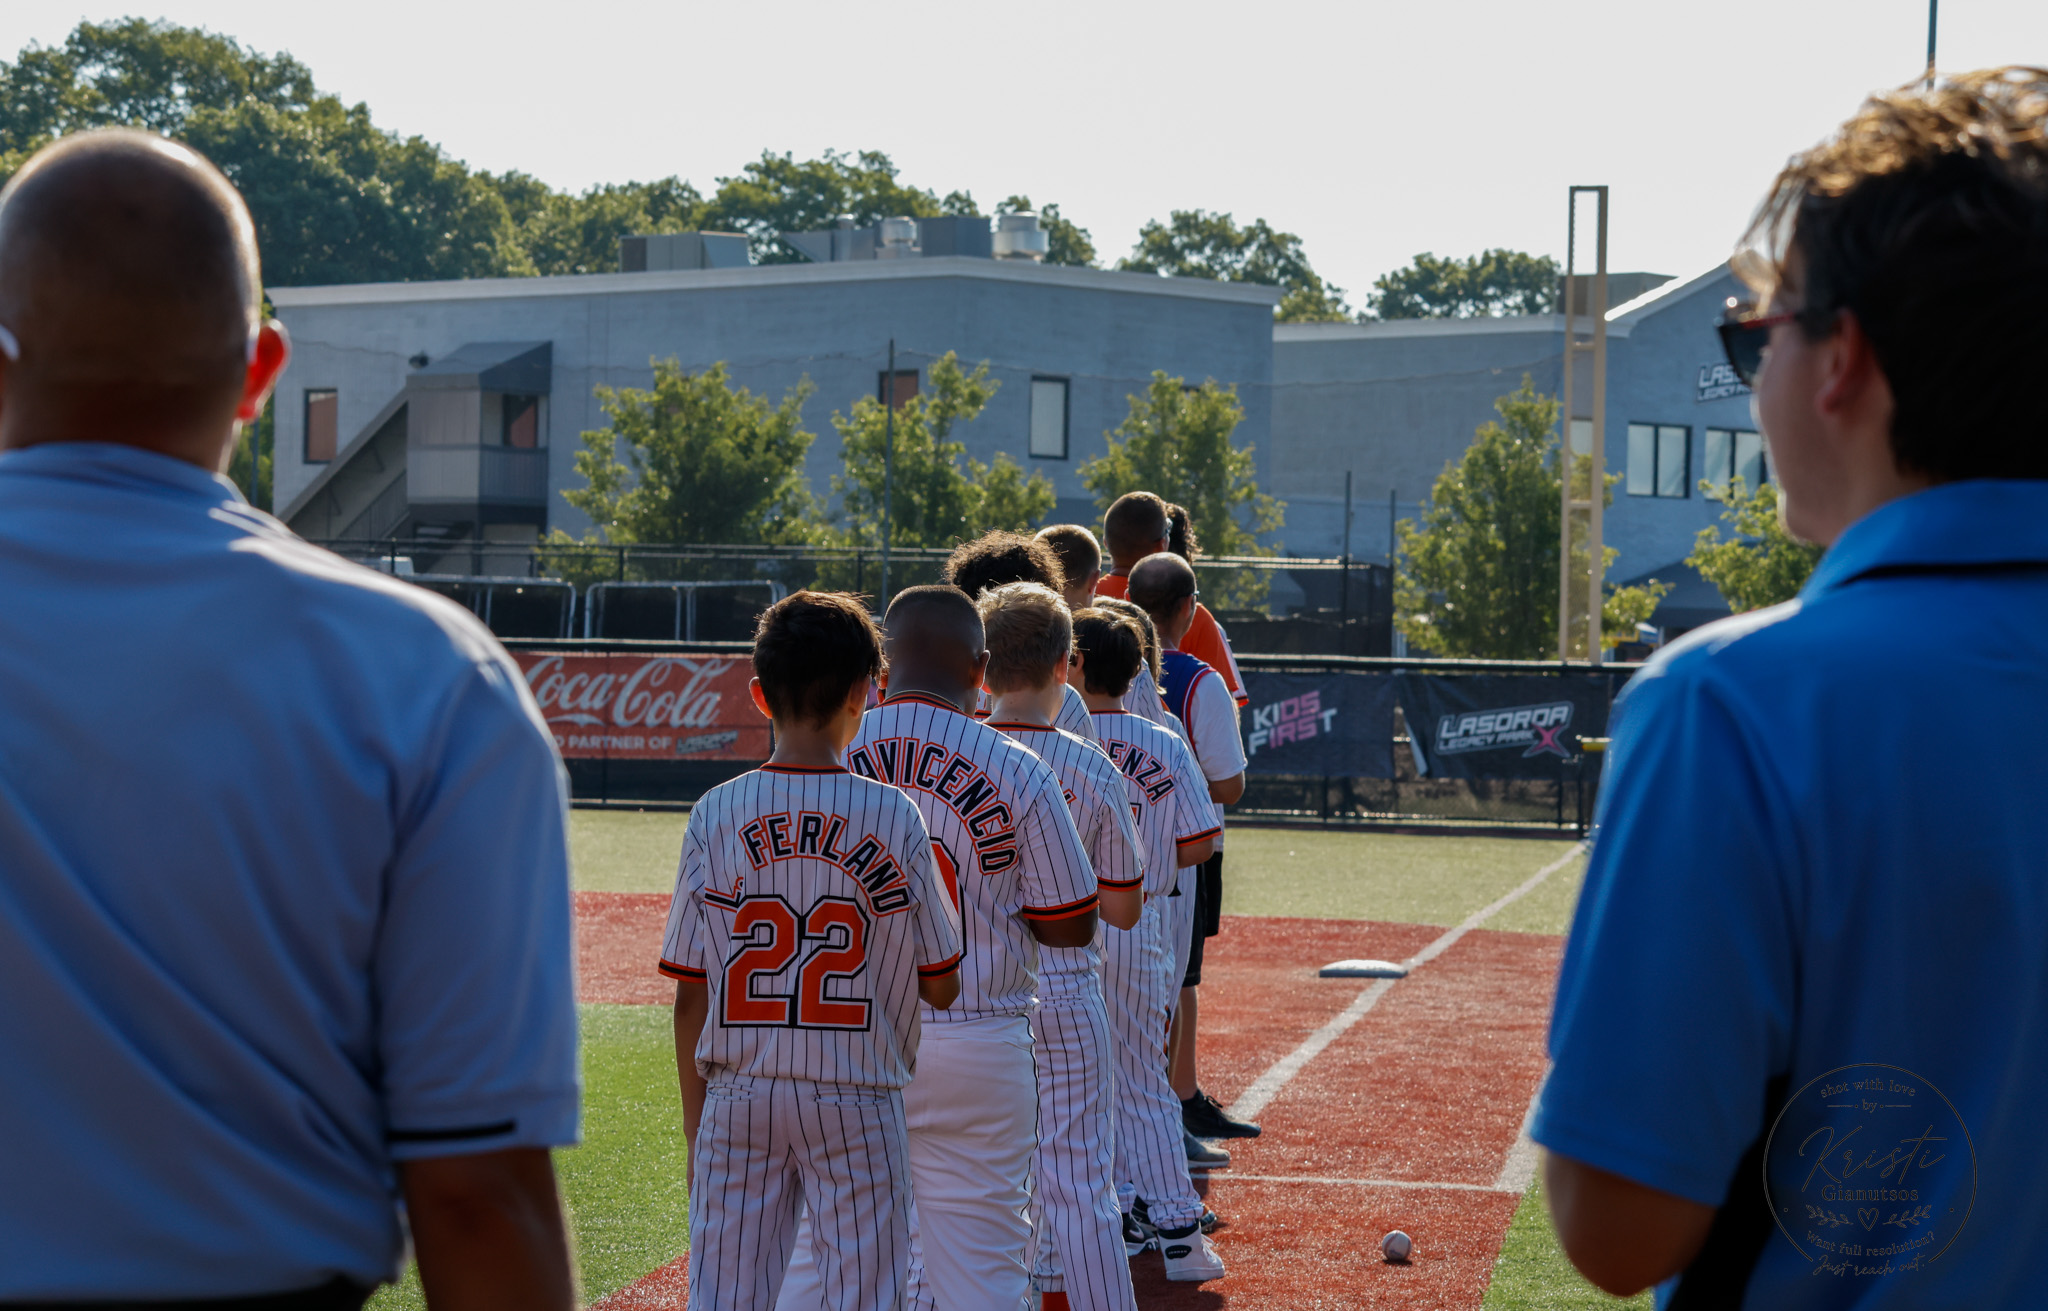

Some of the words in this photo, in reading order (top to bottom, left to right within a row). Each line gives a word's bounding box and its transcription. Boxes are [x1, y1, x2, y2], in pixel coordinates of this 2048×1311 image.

[1248, 708, 1338, 755] FIRST
[1253, 690, 1321, 731] KIDS
[568, 734, 645, 750] PARTNER
[650, 735, 672, 750] OF
[1099, 738, 1175, 807] ENZA
[738, 810, 911, 917] FERLAND
[720, 893, 872, 1032] 22
